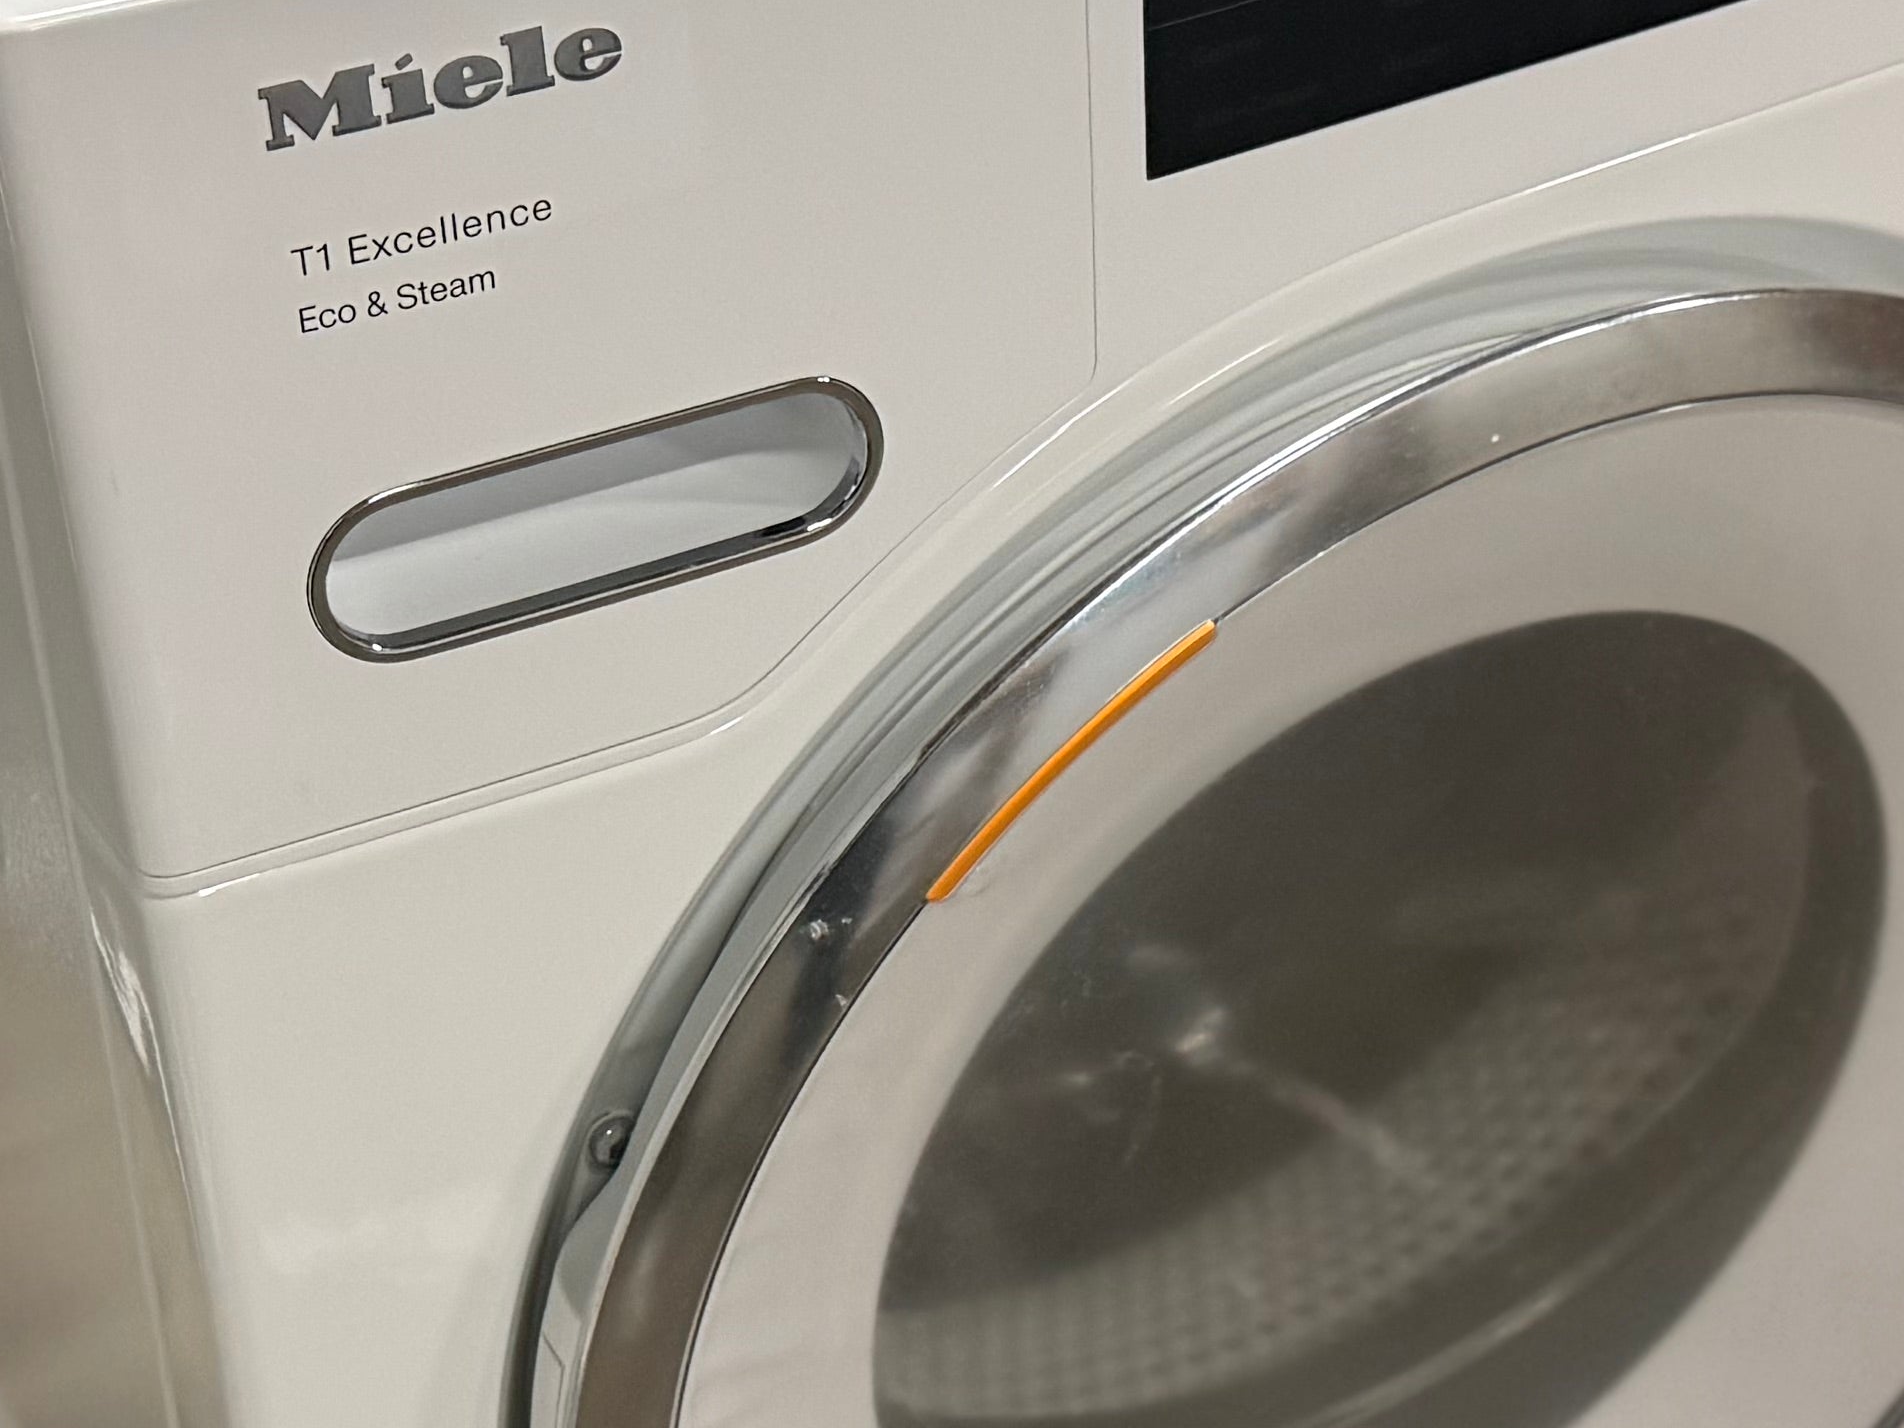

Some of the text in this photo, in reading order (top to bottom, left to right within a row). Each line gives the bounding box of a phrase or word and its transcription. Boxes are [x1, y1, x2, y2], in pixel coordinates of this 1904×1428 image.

[257, 25, 623, 151] Miele
[290, 198, 553, 277] T1 Excellence
[298, 269, 497, 334] Eco & Steam
